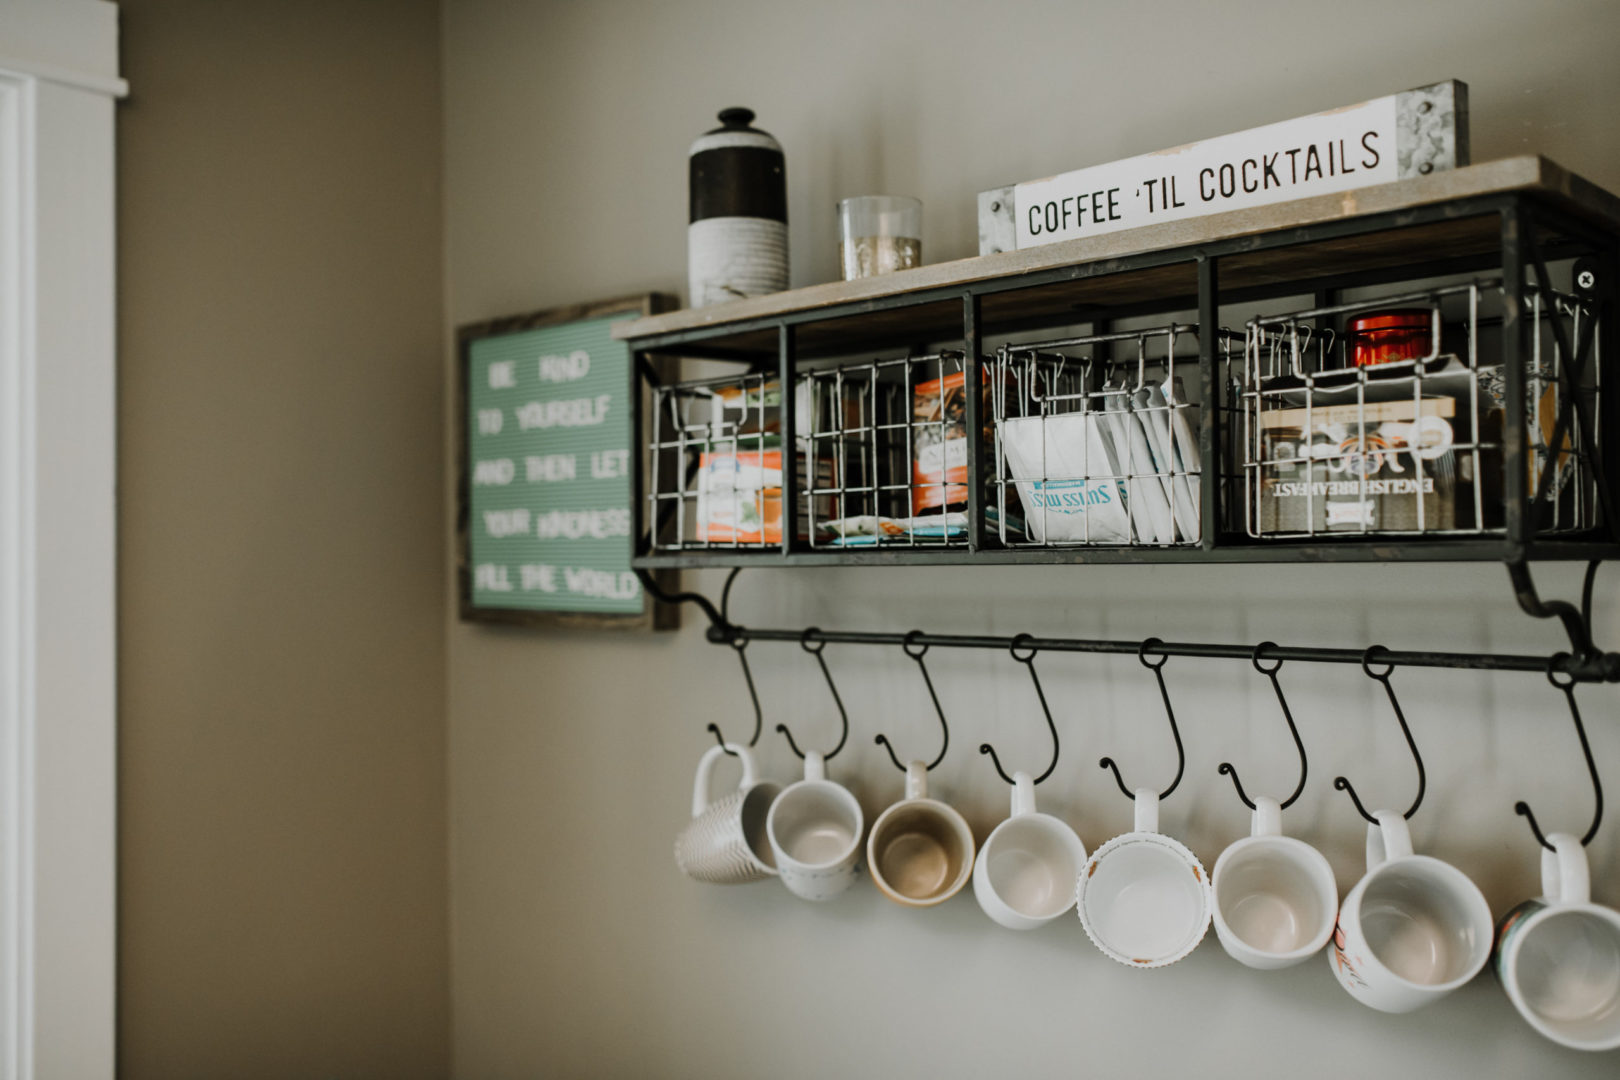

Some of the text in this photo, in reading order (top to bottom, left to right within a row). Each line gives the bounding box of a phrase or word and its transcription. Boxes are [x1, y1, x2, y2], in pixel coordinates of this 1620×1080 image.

[1028, 131, 1380, 236] COFFEE 'TIL COCKTAILS
[488, 350, 590, 389] BE KIND
[478, 395, 610, 435] TO YOURSELF
[473, 449, 629, 485] AND THEN LET
[1273, 478, 1434, 497] ENGLISH BREAKFAST
[483, 508, 630, 539] YOUR KINDNESS
[475, 563, 639, 600] FILL THE WORLD
